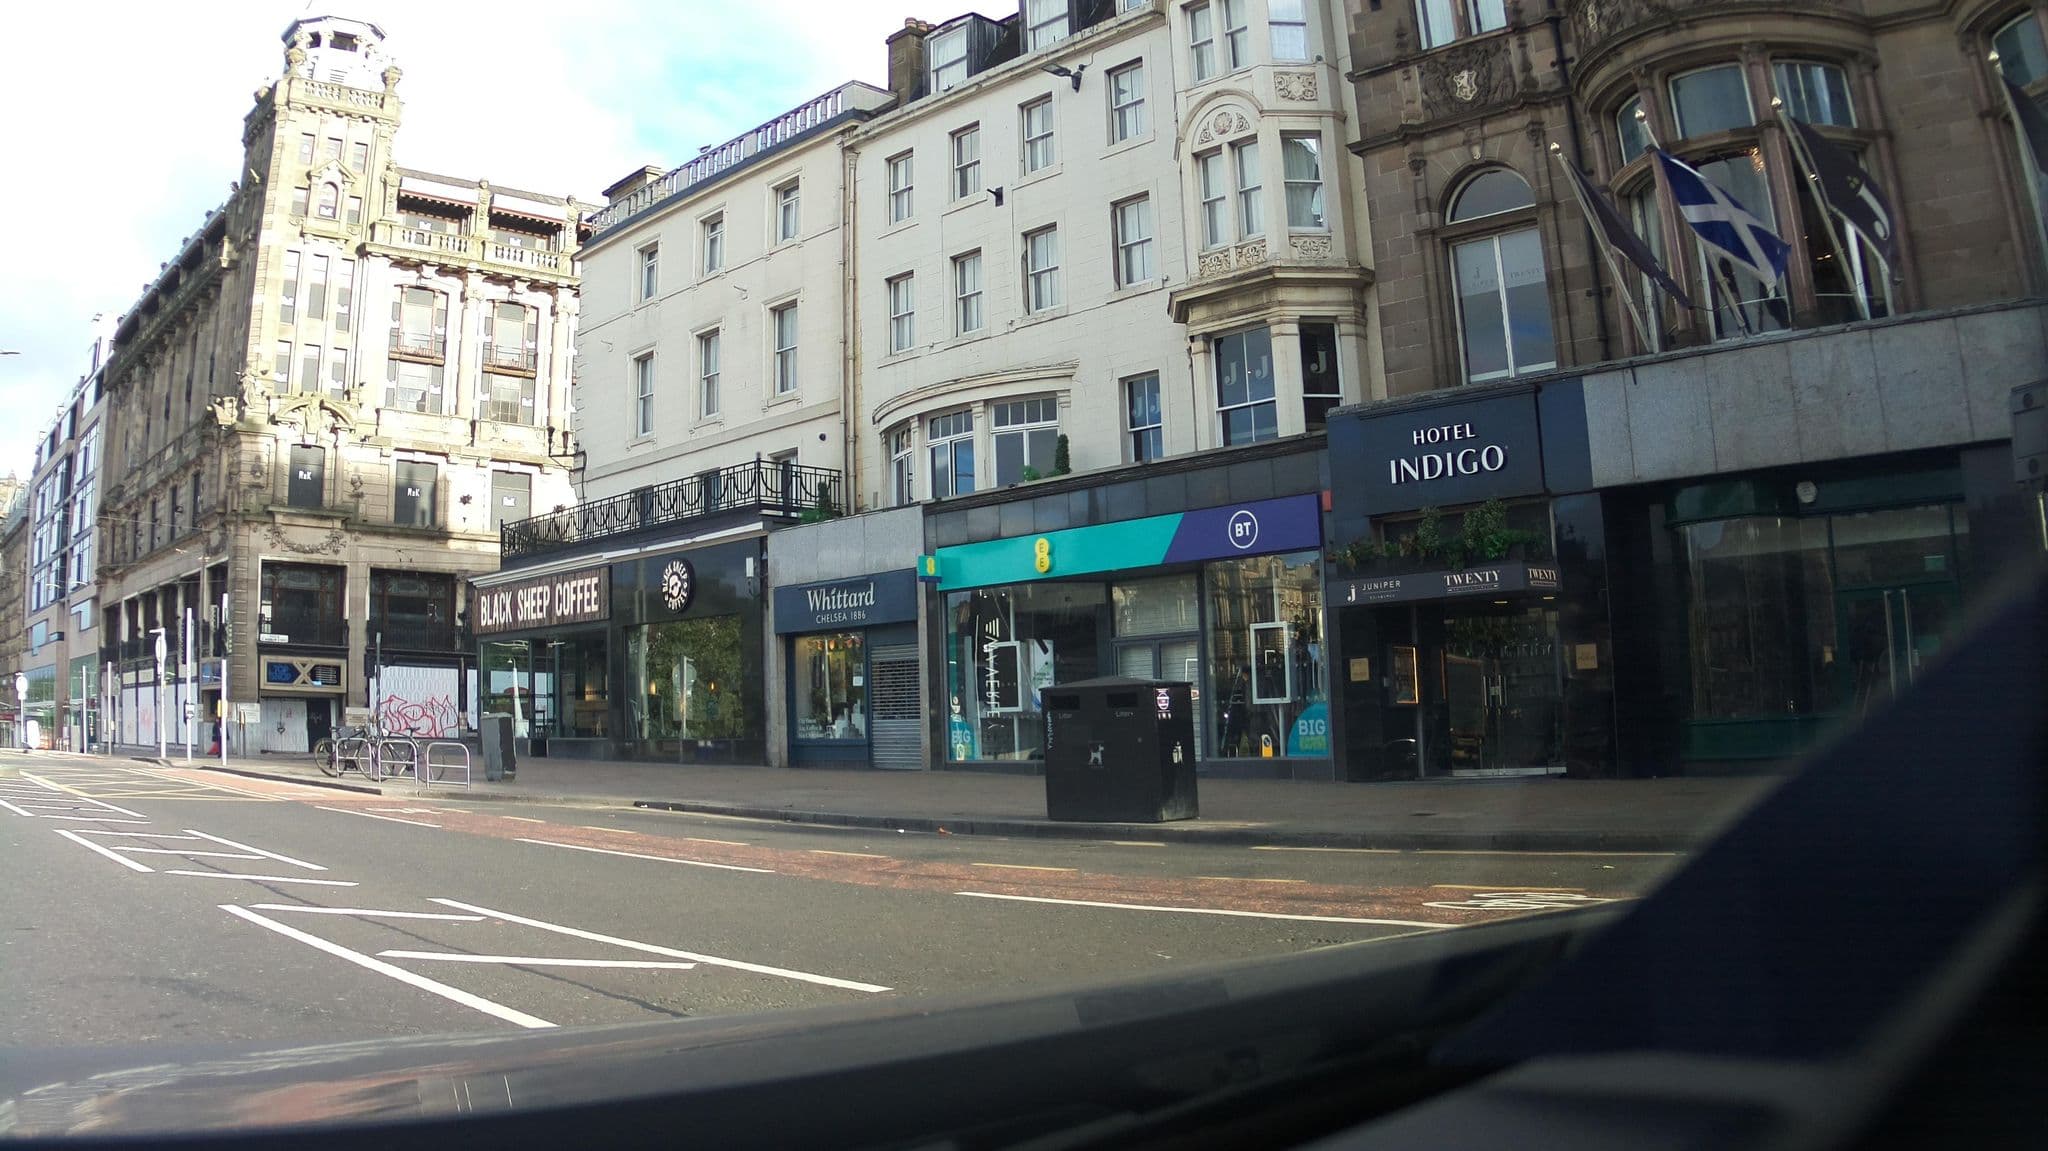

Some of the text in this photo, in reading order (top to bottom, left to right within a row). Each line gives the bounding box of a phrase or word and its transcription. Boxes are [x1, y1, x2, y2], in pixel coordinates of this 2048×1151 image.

[1413, 423, 1476, 446] HOTEL
[1389, 445, 1504, 485] INDIGO
[1235, 522, 1251, 537] BT
[661, 563, 673, 593] BLACK
[1444, 569, 1500, 586] TWENTY
[1527, 567, 1557, 581] TWENTY
[1362, 580, 1401, 591] JUNIPER
[480, 576, 600, 627] BLACK SHEEP COFFEE
[807, 582, 875, 612] Whittard
[816, 609, 866, 624] CHELSEA 1886
[1299, 719, 1326, 735] BIG
